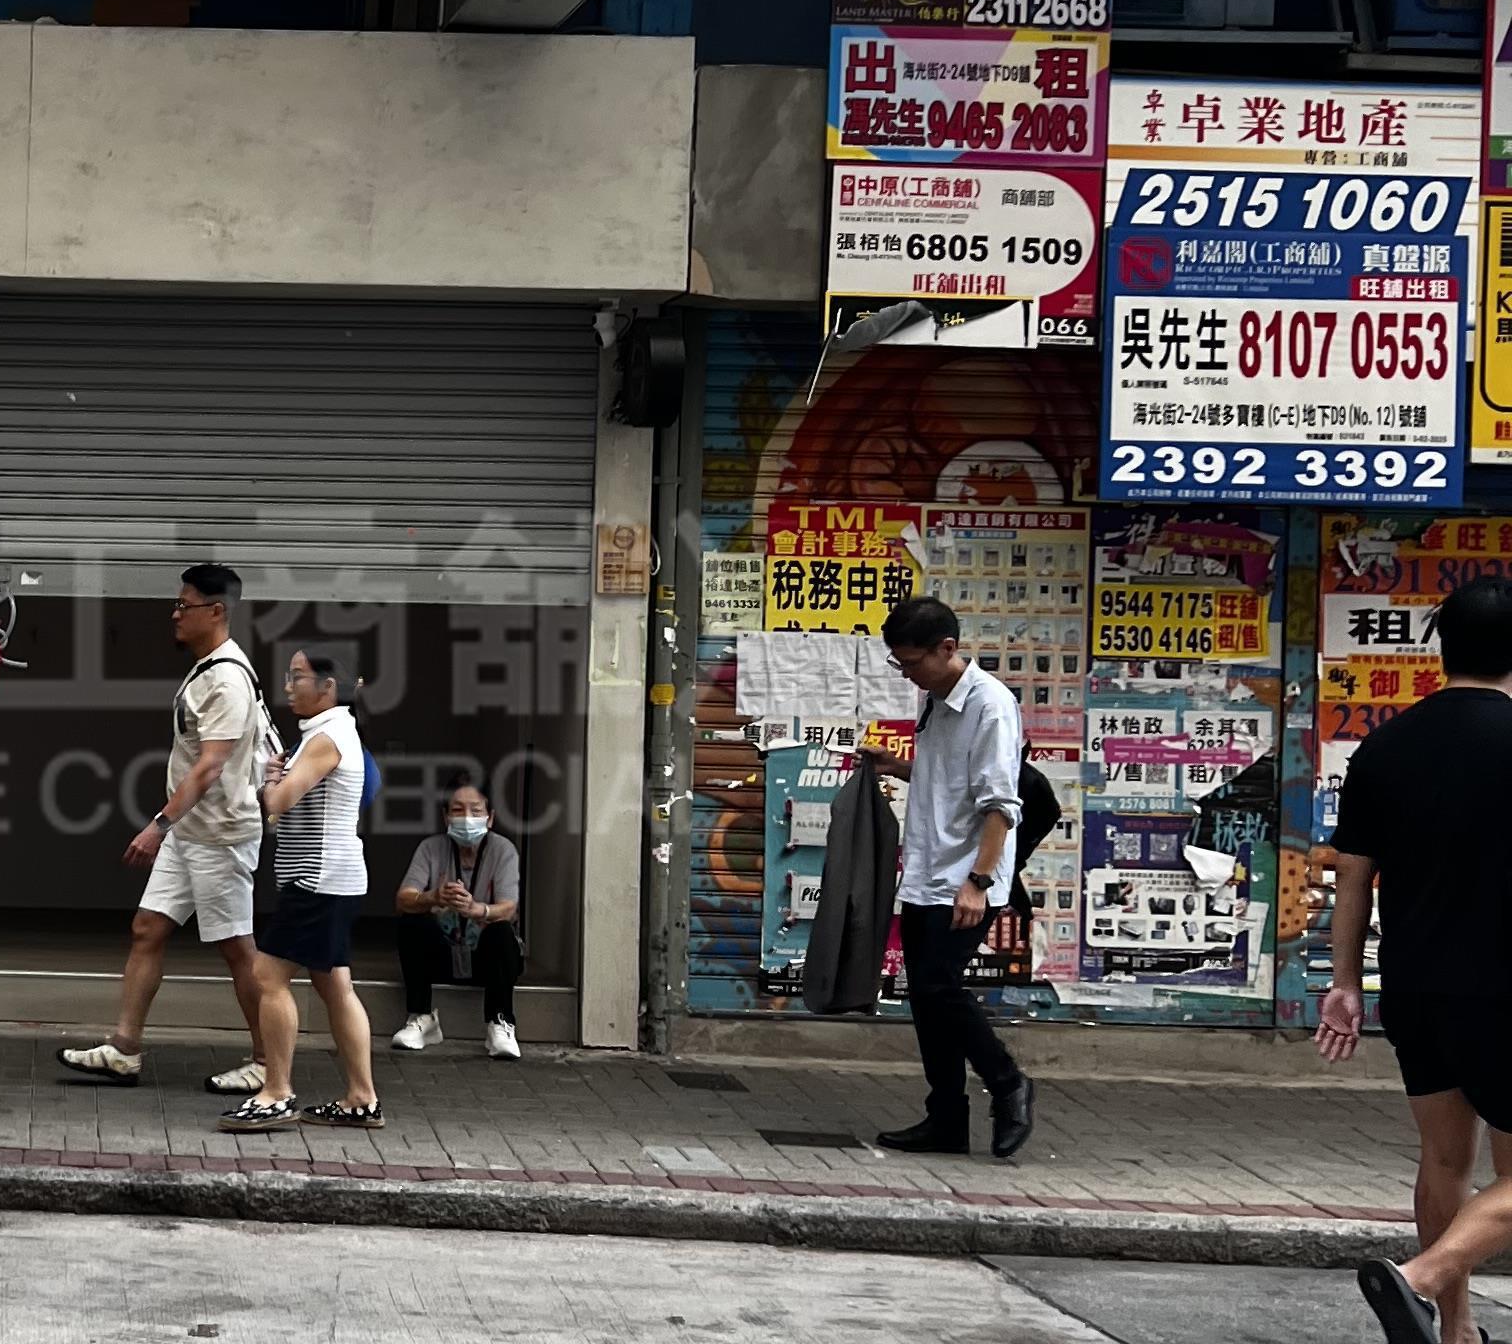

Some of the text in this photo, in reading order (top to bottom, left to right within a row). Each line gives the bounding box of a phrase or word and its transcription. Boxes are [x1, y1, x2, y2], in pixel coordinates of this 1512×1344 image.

[845, 40, 897, 94] 出
[1034, 46, 1090, 99] 租
[927, 100, 1005, 149] 9465
[1010, 102, 1088, 153] 2083
[1177, 93, 1409, 147] 卓業地產
[1130, 172, 1452, 234] 2515 1060
[906, 233, 989, 263] 6805
[1001, 235, 1083, 266] 1509
[1362, 243, 1451, 274] 真盤源
[1121, 307, 1449, 381] 吳先生 8107 0553
[1110, 444, 1448, 489] 2392 3392
[772, 529, 903, 556] 會計事務
[1100, 590, 1154, 618] 9544
[1160, 591, 1214, 619] 7175
[1099, 624, 1154, 653] 5530
[1158, 626, 1213, 654] 4146
